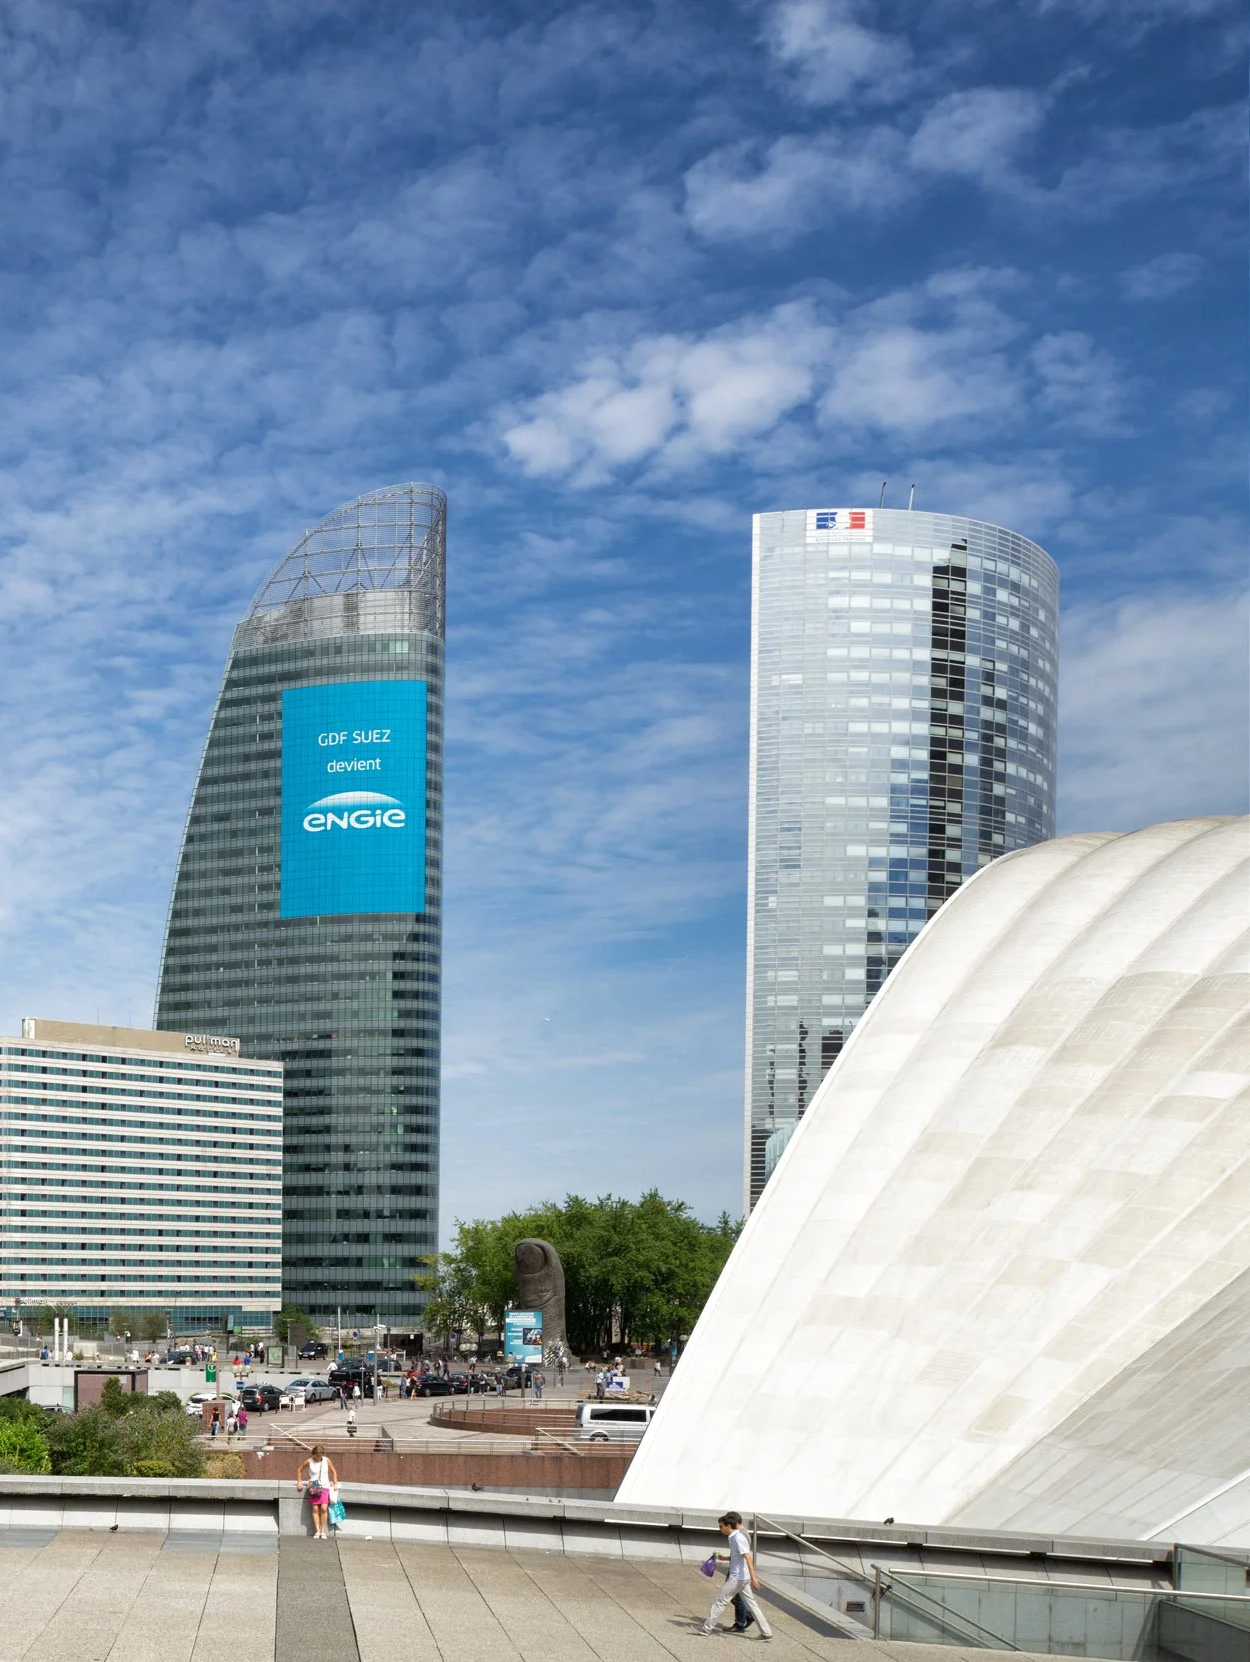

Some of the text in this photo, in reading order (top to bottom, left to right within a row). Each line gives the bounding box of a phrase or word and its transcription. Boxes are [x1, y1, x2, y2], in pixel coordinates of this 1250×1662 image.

[318, 729, 391, 746] GDF SUEZ
[327, 757, 382, 773] devient
